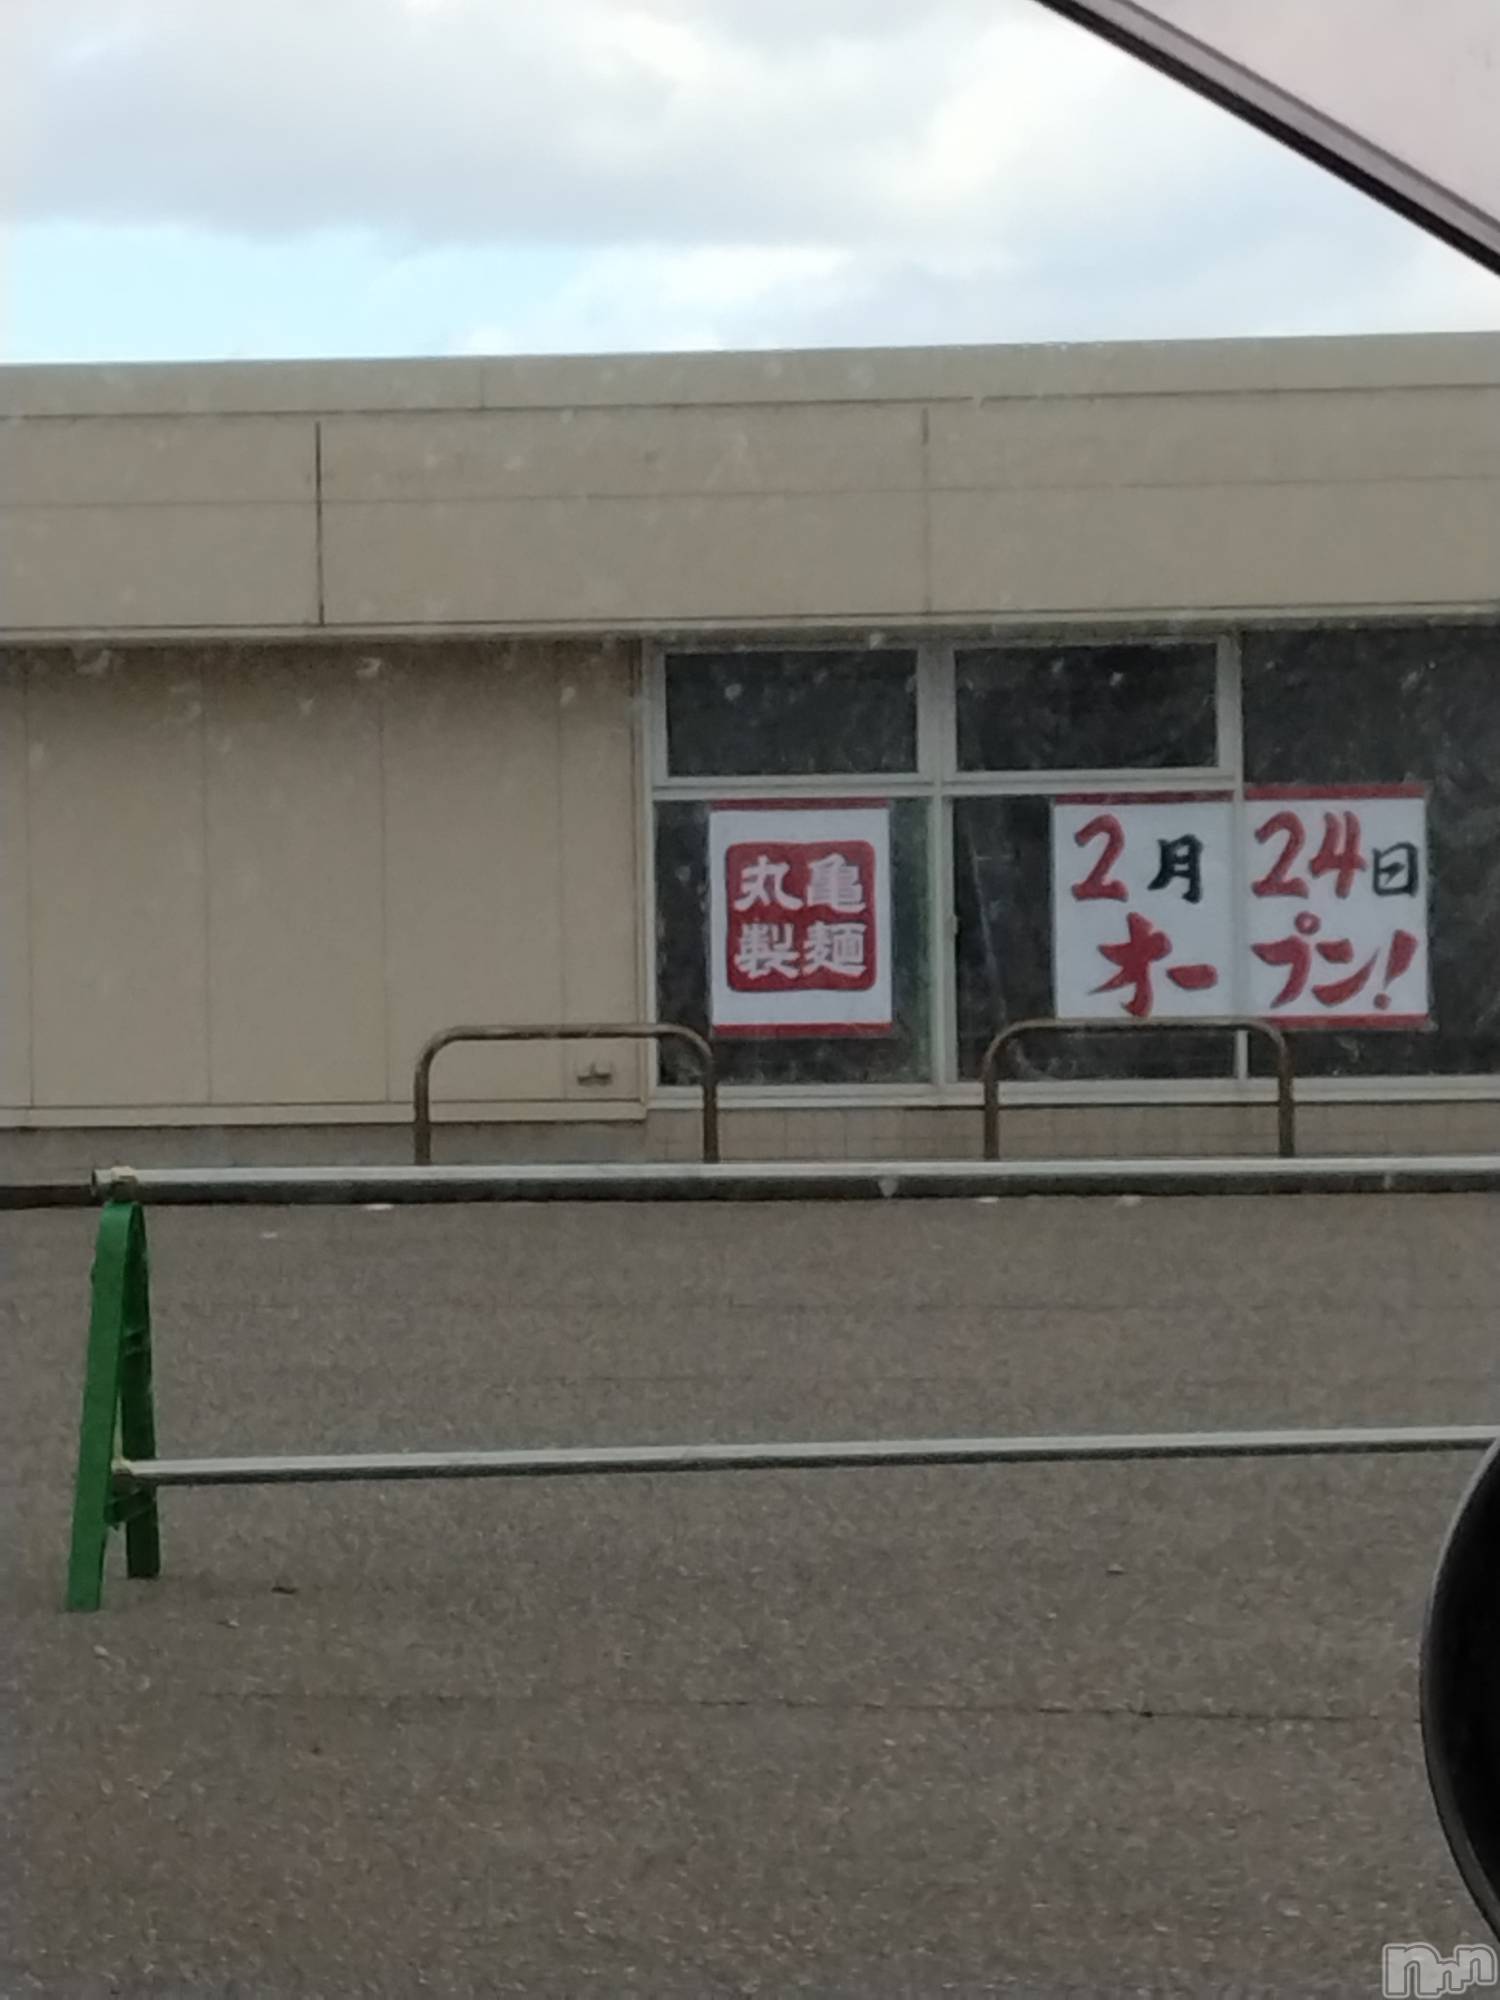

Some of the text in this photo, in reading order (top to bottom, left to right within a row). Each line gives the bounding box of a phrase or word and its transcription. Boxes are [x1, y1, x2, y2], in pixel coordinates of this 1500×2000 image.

[734, 853, 867, 914] 丸亀
[1071, 810, 1419, 904] 2月24日
[734, 918, 867, 979] 製麺
